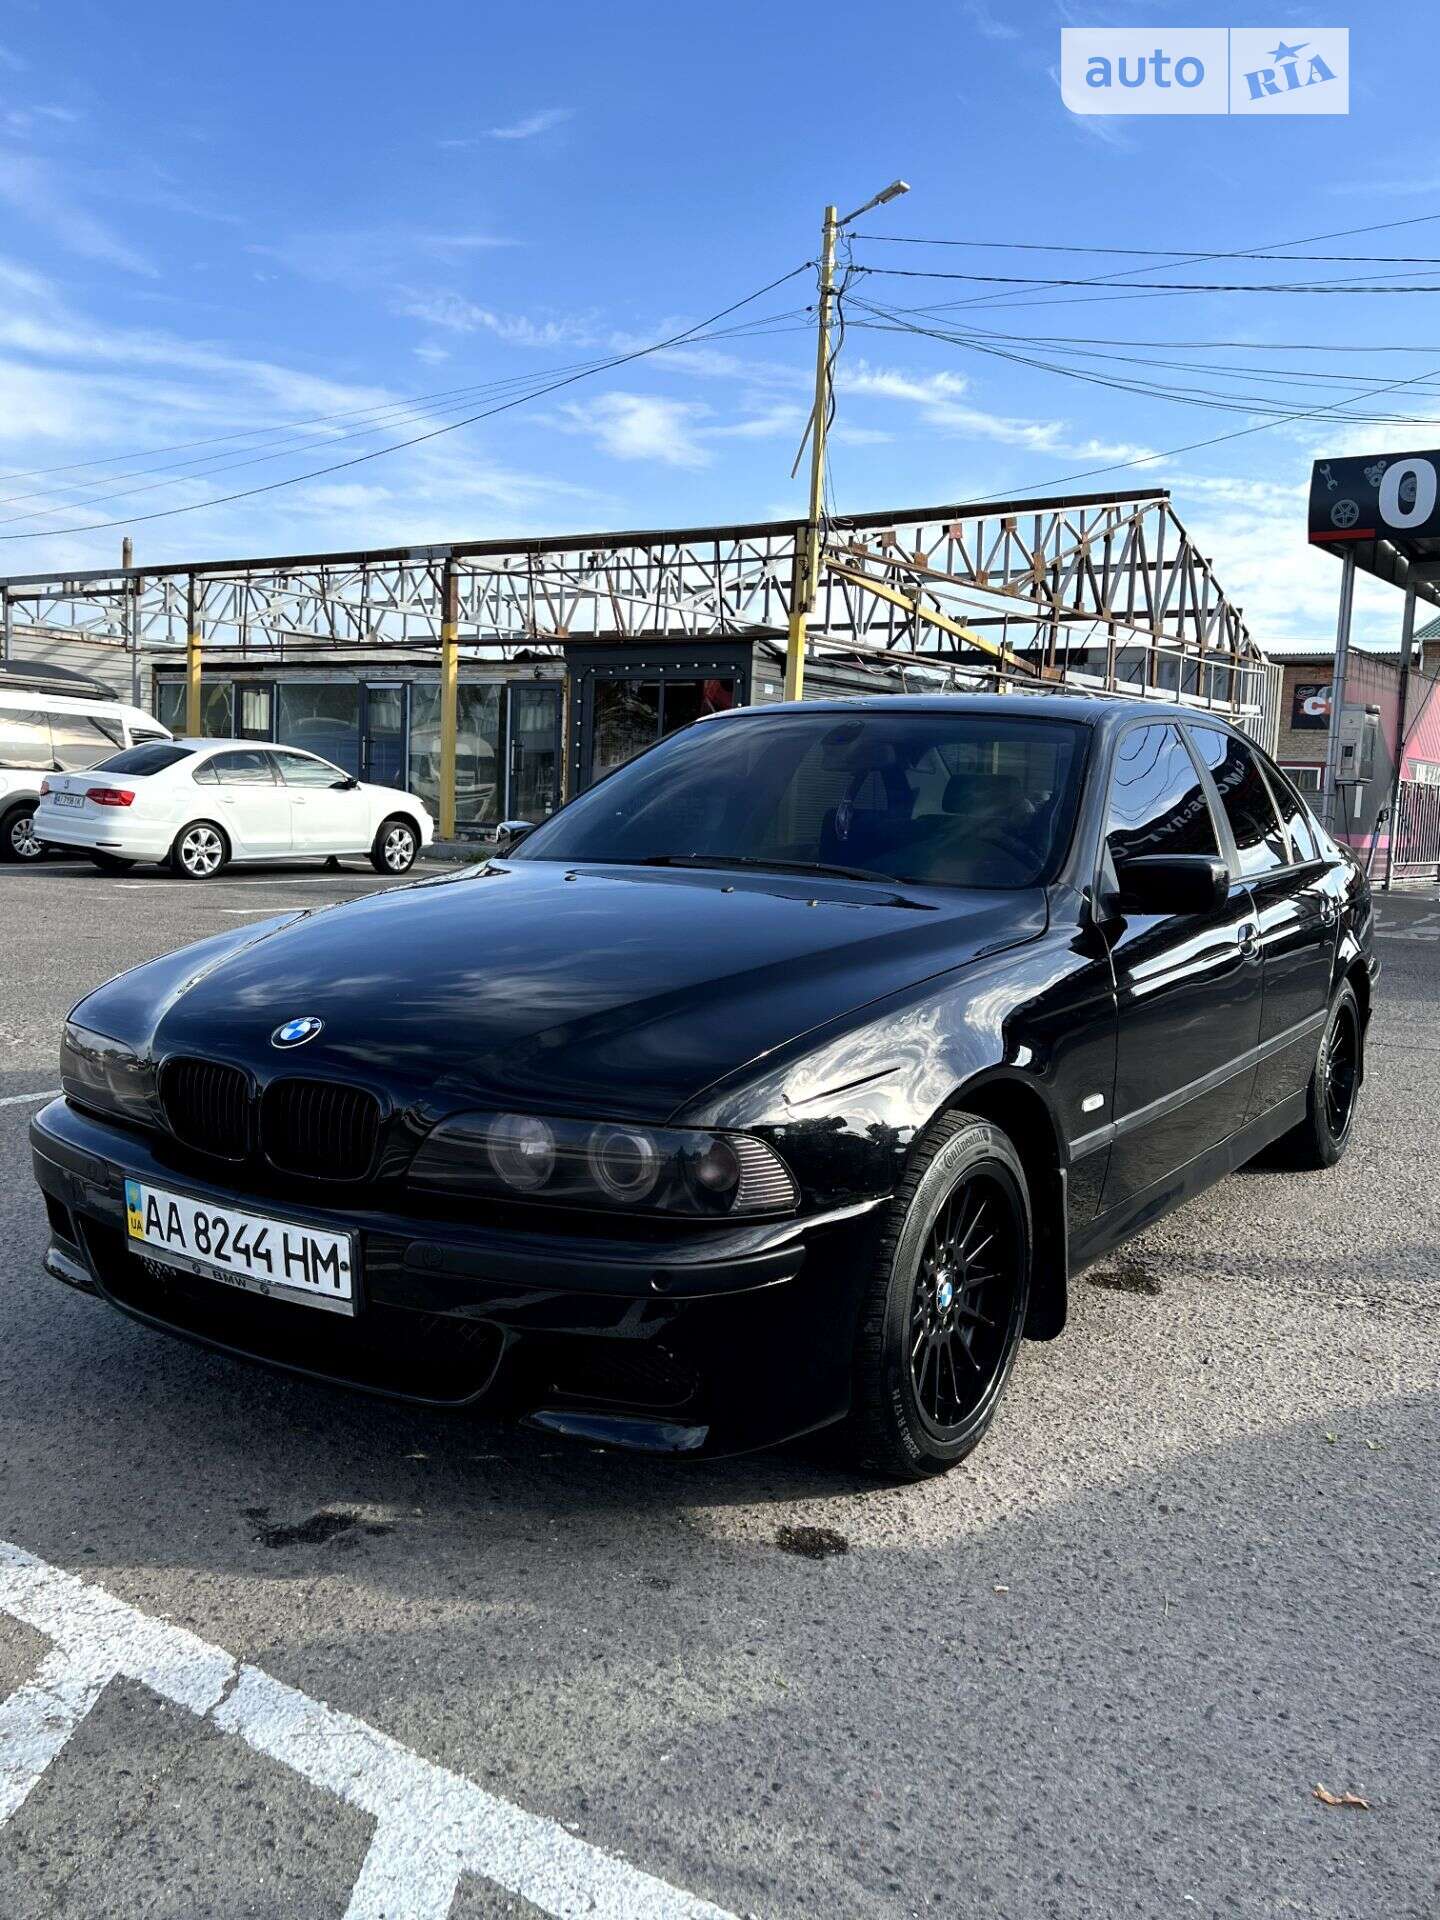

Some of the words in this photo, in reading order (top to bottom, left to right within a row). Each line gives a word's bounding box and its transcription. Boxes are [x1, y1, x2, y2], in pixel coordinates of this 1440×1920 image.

[943, 1128, 984, 1169] Continental
[130, 1217, 143, 1233] UA
[145, 1194, 187, 1248] AA
[193, 1211, 273, 1274] 8244
[282, 1232, 341, 1289] HM
[212, 1270, 246, 1288] BMW
